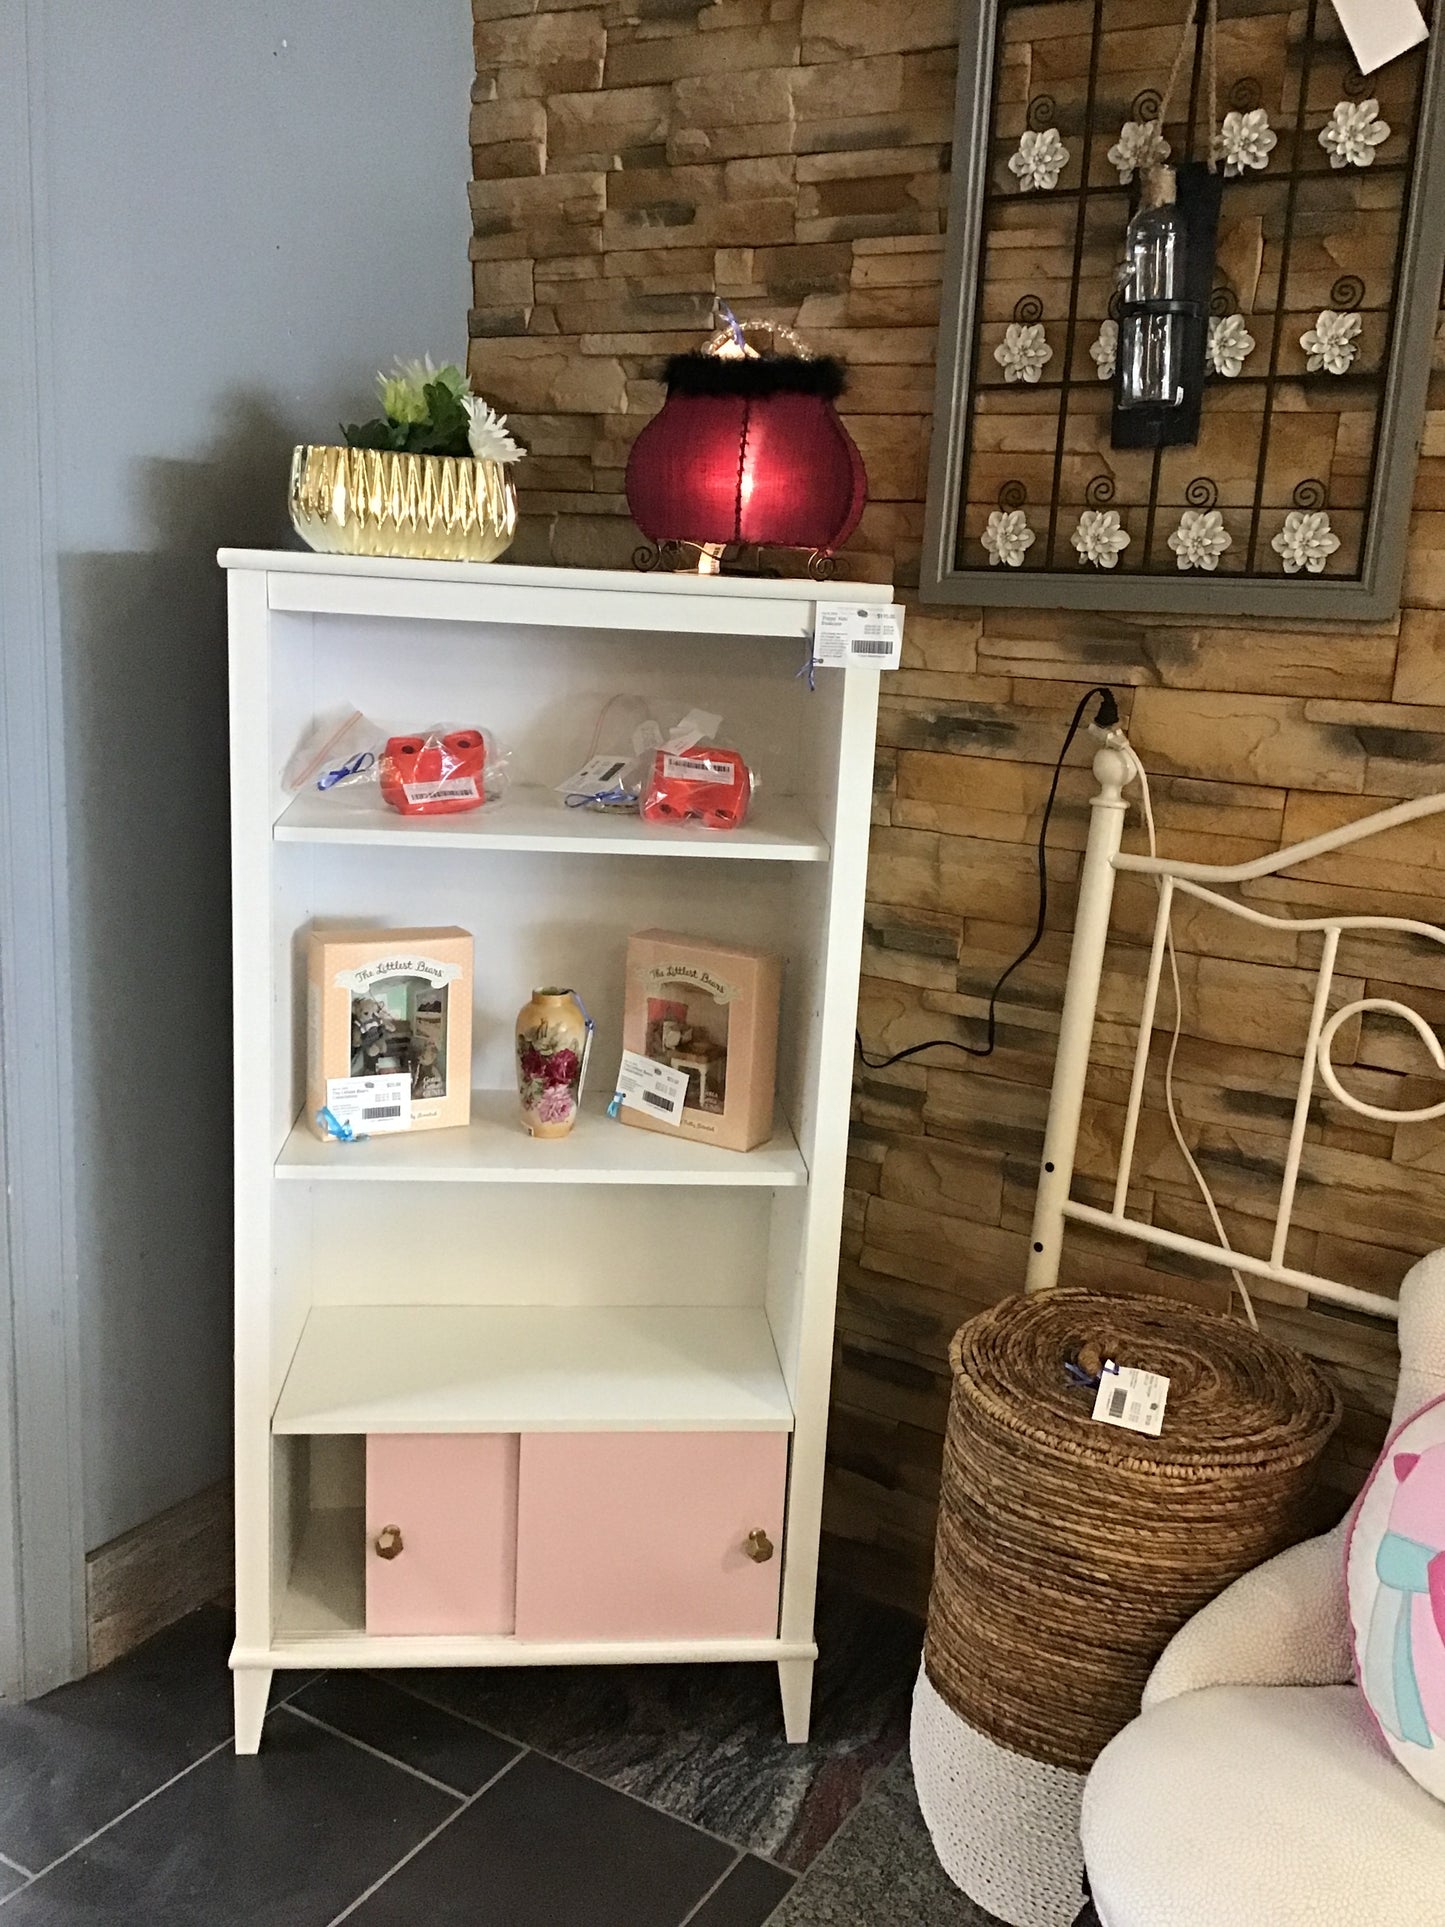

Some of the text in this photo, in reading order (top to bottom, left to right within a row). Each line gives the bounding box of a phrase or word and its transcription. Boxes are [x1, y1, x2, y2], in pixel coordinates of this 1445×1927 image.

[354, 960, 443, 983] The Littlest Bears
[649, 966, 724, 994] The Littlest Bears
